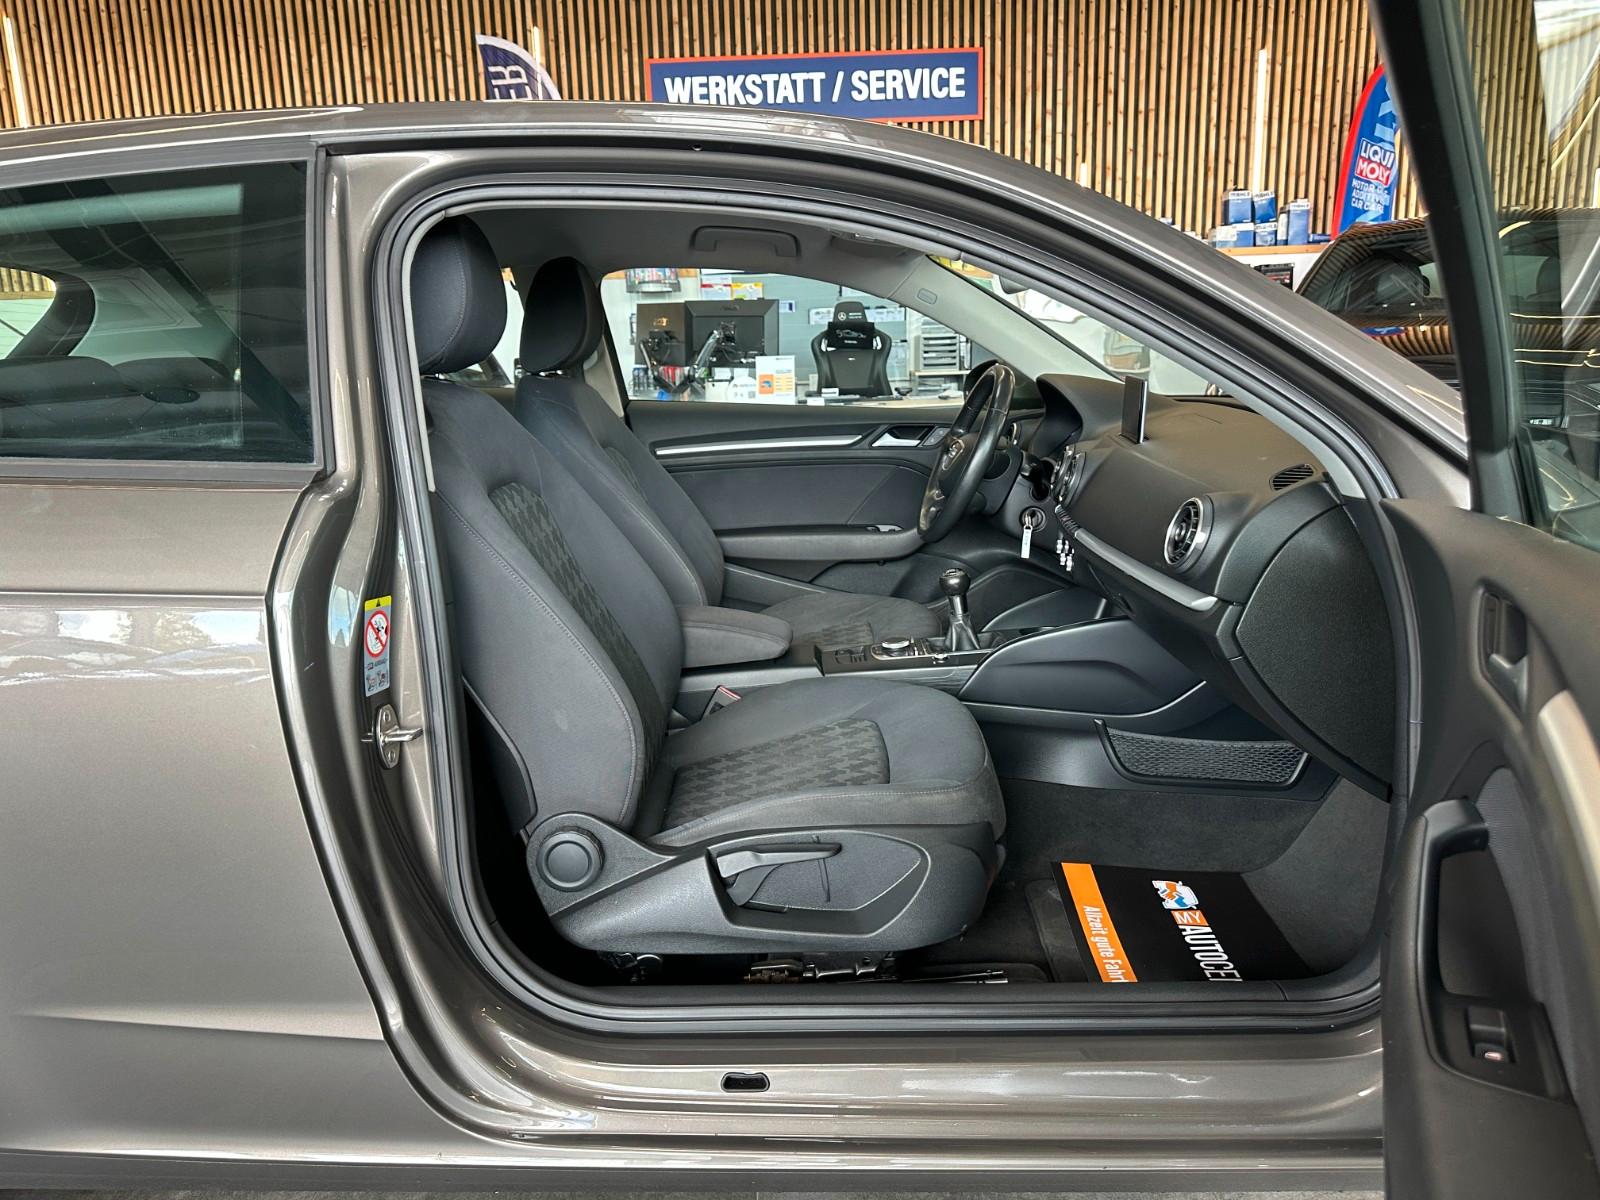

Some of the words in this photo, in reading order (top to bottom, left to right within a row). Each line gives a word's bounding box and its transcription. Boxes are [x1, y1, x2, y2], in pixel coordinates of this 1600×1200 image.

[664, 72, 826, 106] WERKSTATT
[831, 71, 845, 102] /
[850, 67, 966, 102] SERVICE
[1361, 141, 1394, 168] LIQUI
[1356, 158, 1391, 185] MOLY
[1083, 905, 1108, 935] Allzeit
[1174, 911, 1201, 924] MY
[1091, 936, 1115, 958] gute
[1178, 925, 1243, 982] AUTOCE
